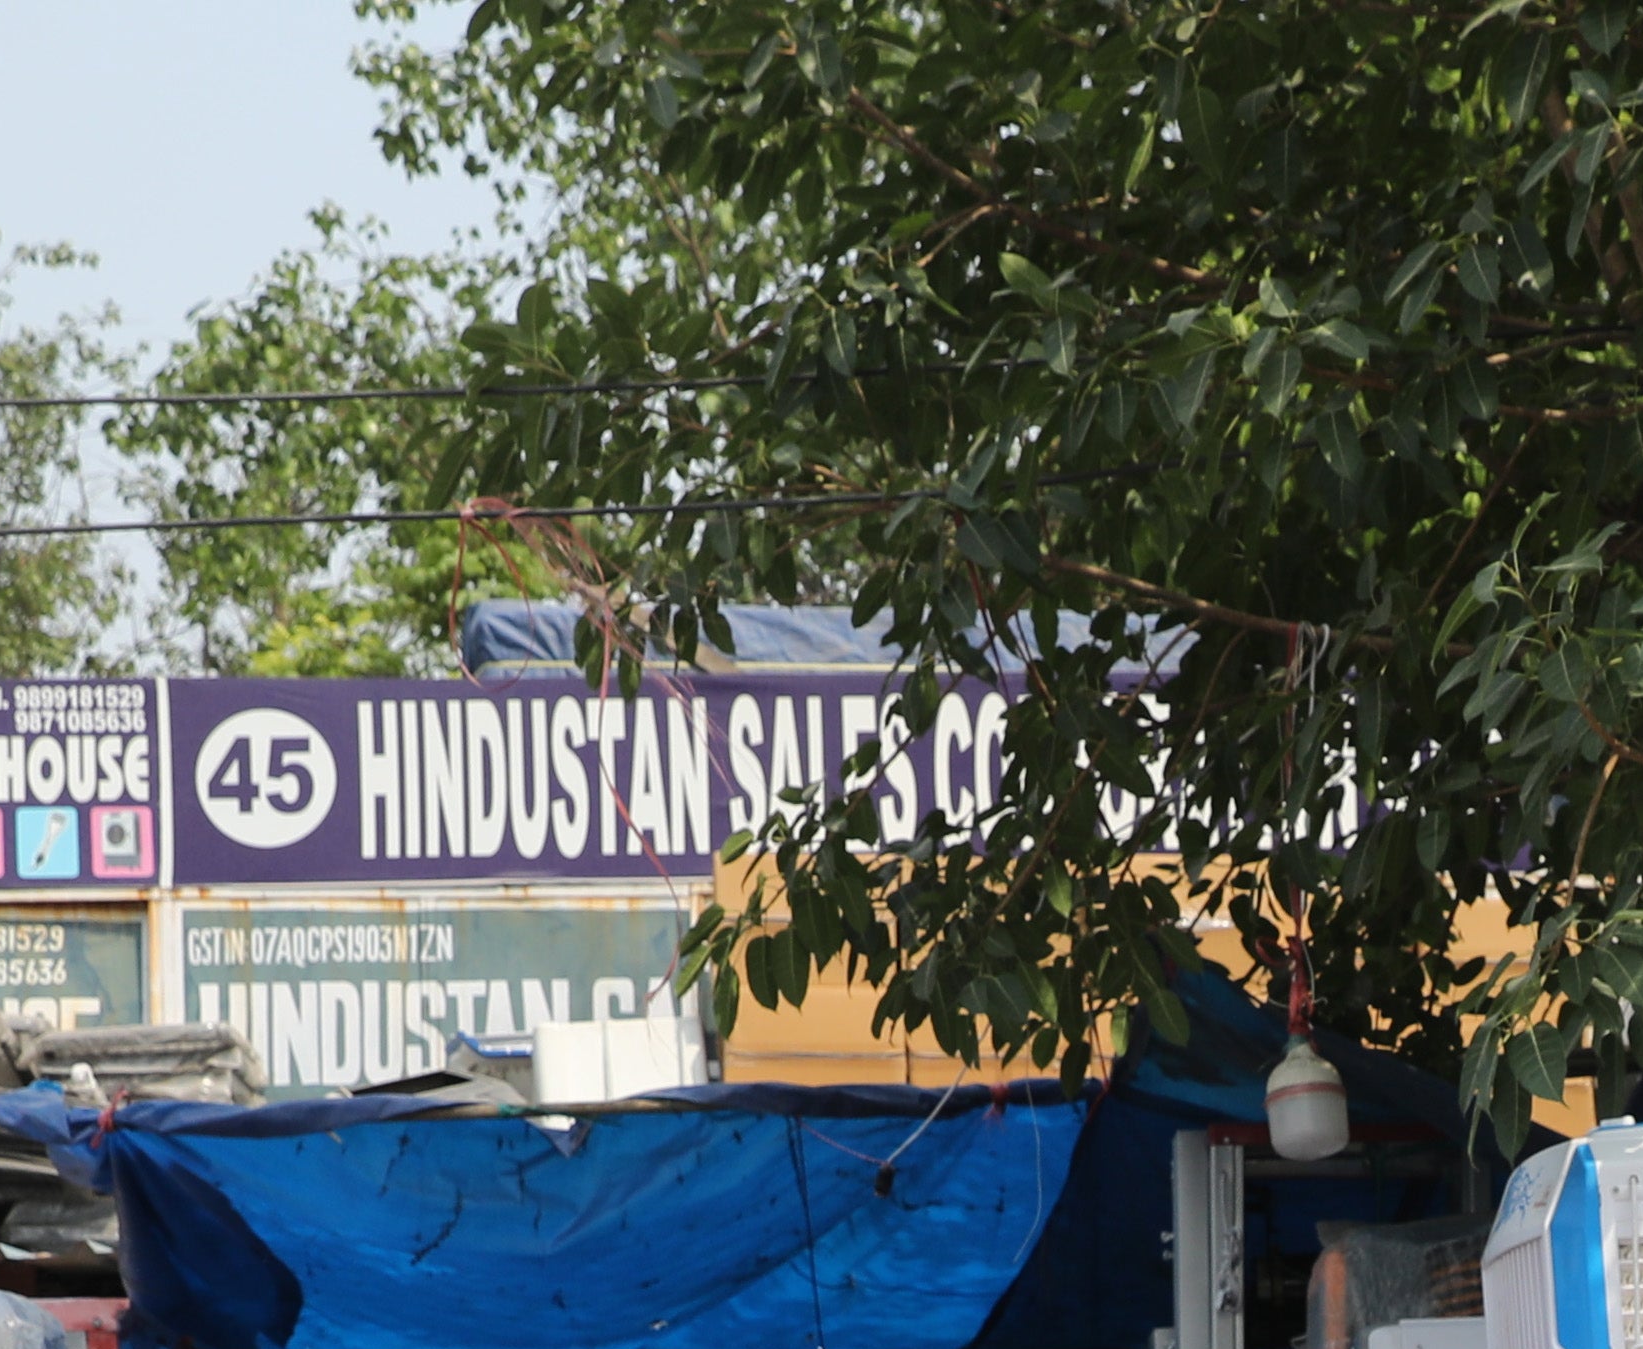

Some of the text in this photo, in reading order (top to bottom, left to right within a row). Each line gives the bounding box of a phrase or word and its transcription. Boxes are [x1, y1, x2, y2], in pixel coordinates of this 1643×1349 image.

[14, 684, 145, 710] 9899181529
[15, 709, 146, 733] 9871085636
[207, 737, 316, 816] 45
[359, 696, 712, 861] HINDUSTAN
